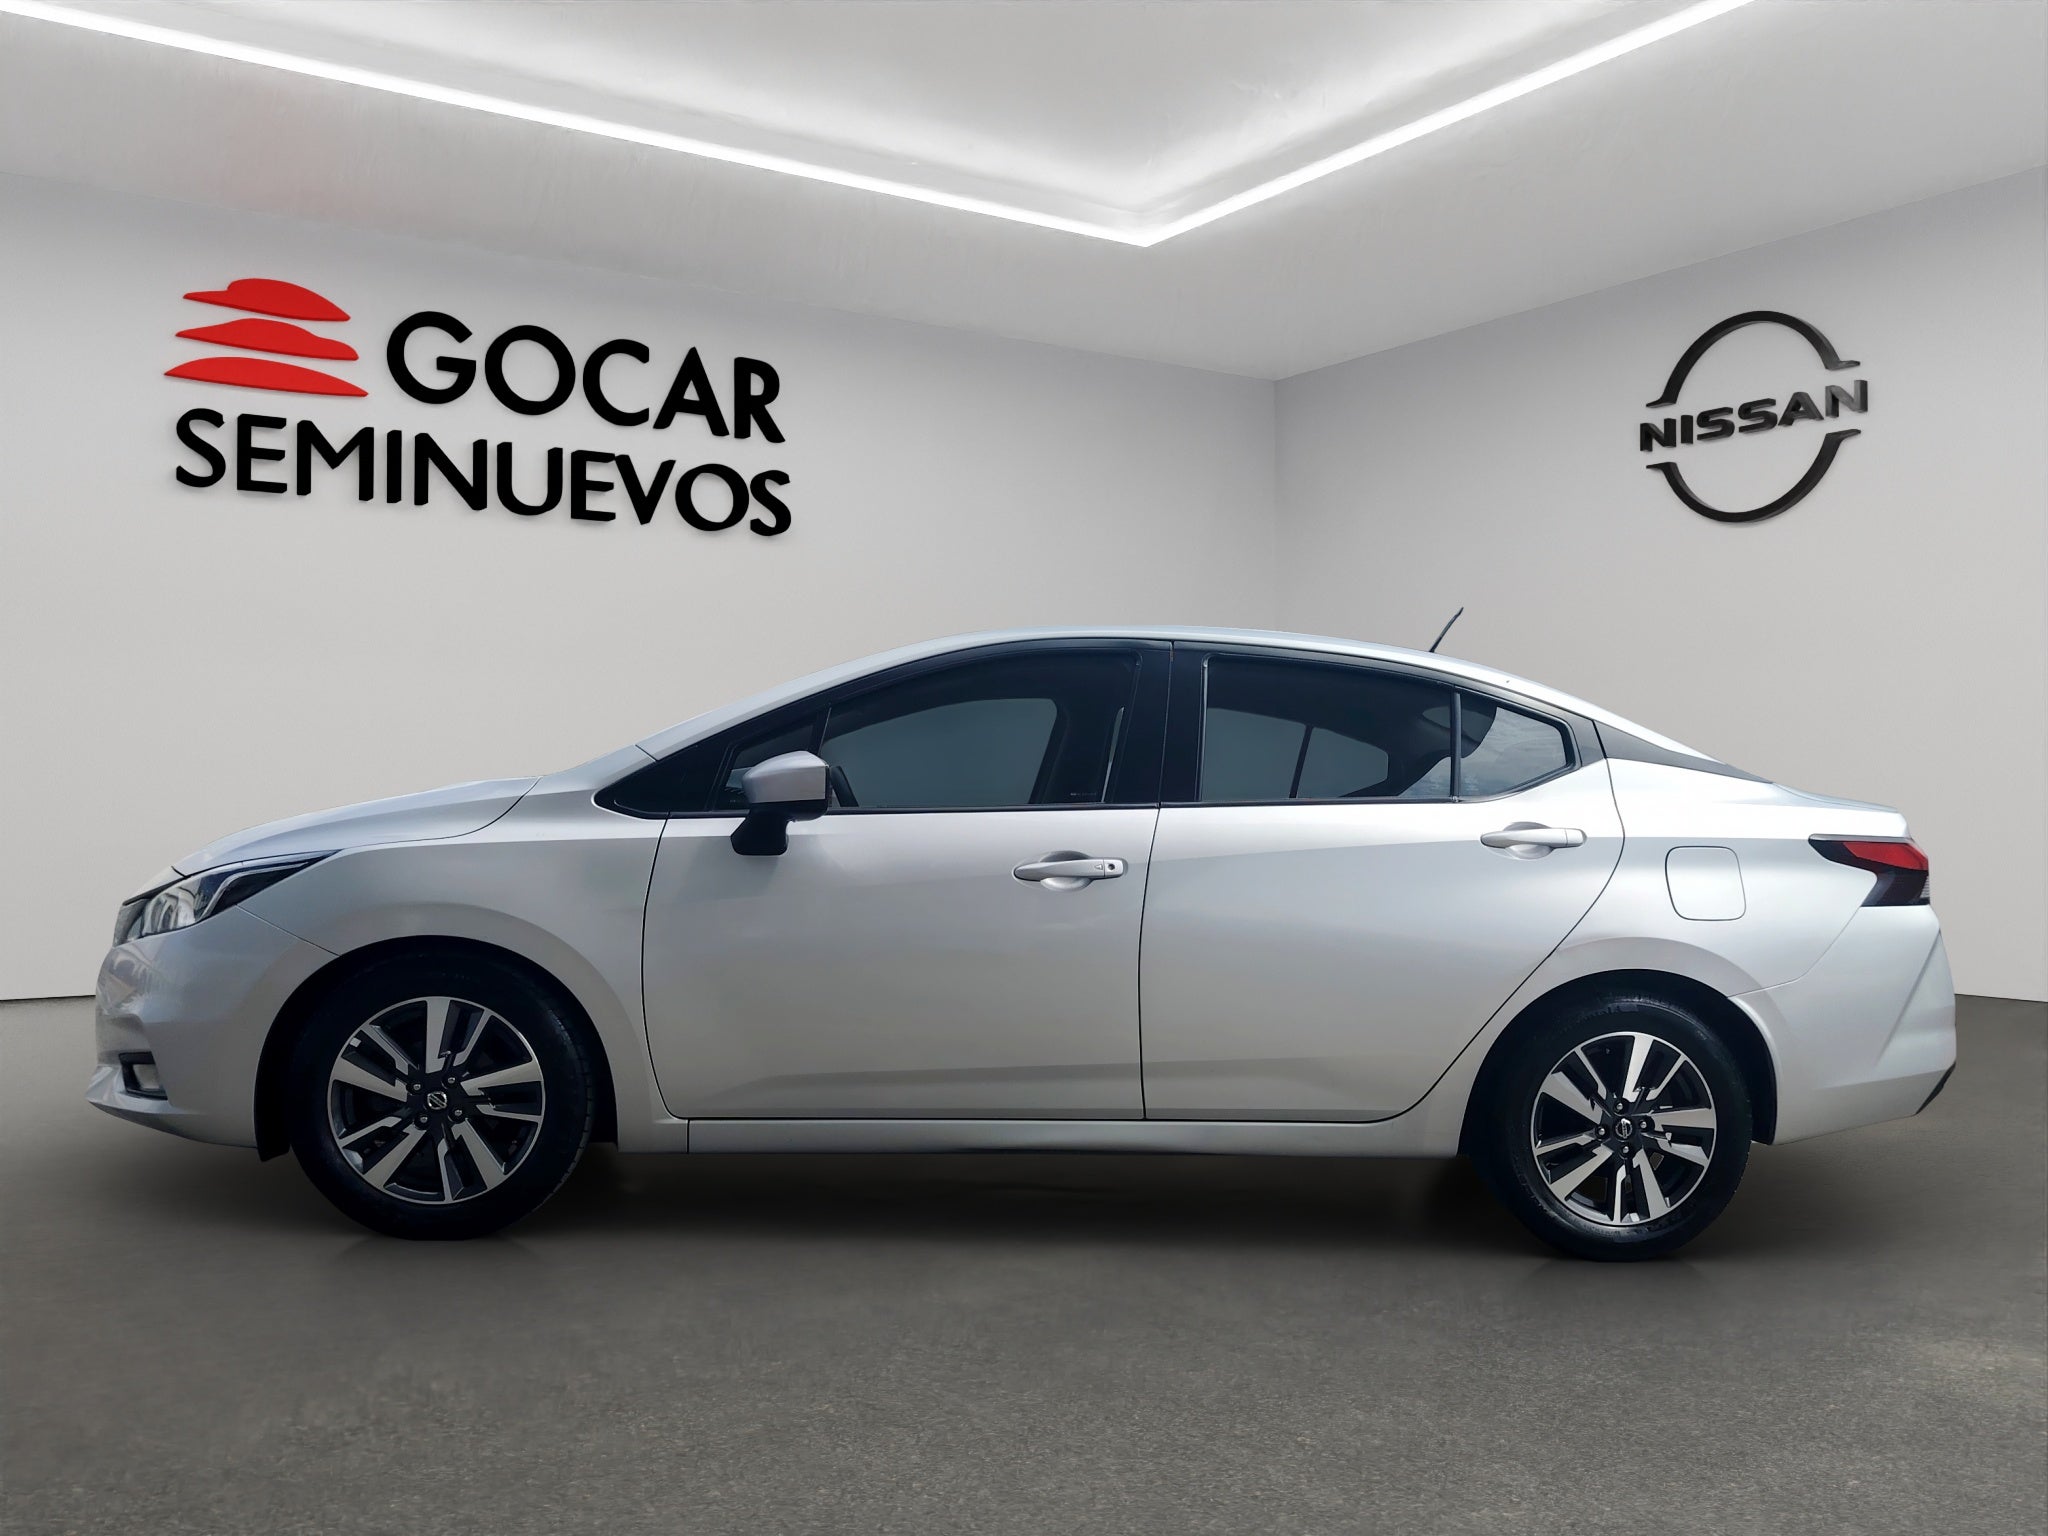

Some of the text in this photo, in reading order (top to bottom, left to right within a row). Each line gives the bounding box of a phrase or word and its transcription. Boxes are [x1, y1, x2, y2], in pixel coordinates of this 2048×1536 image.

[386, 310, 786, 444] GOCAR
[1639, 379, 1869, 453] NISSAN
[175, 407, 793, 537] SEMINUEVOS
